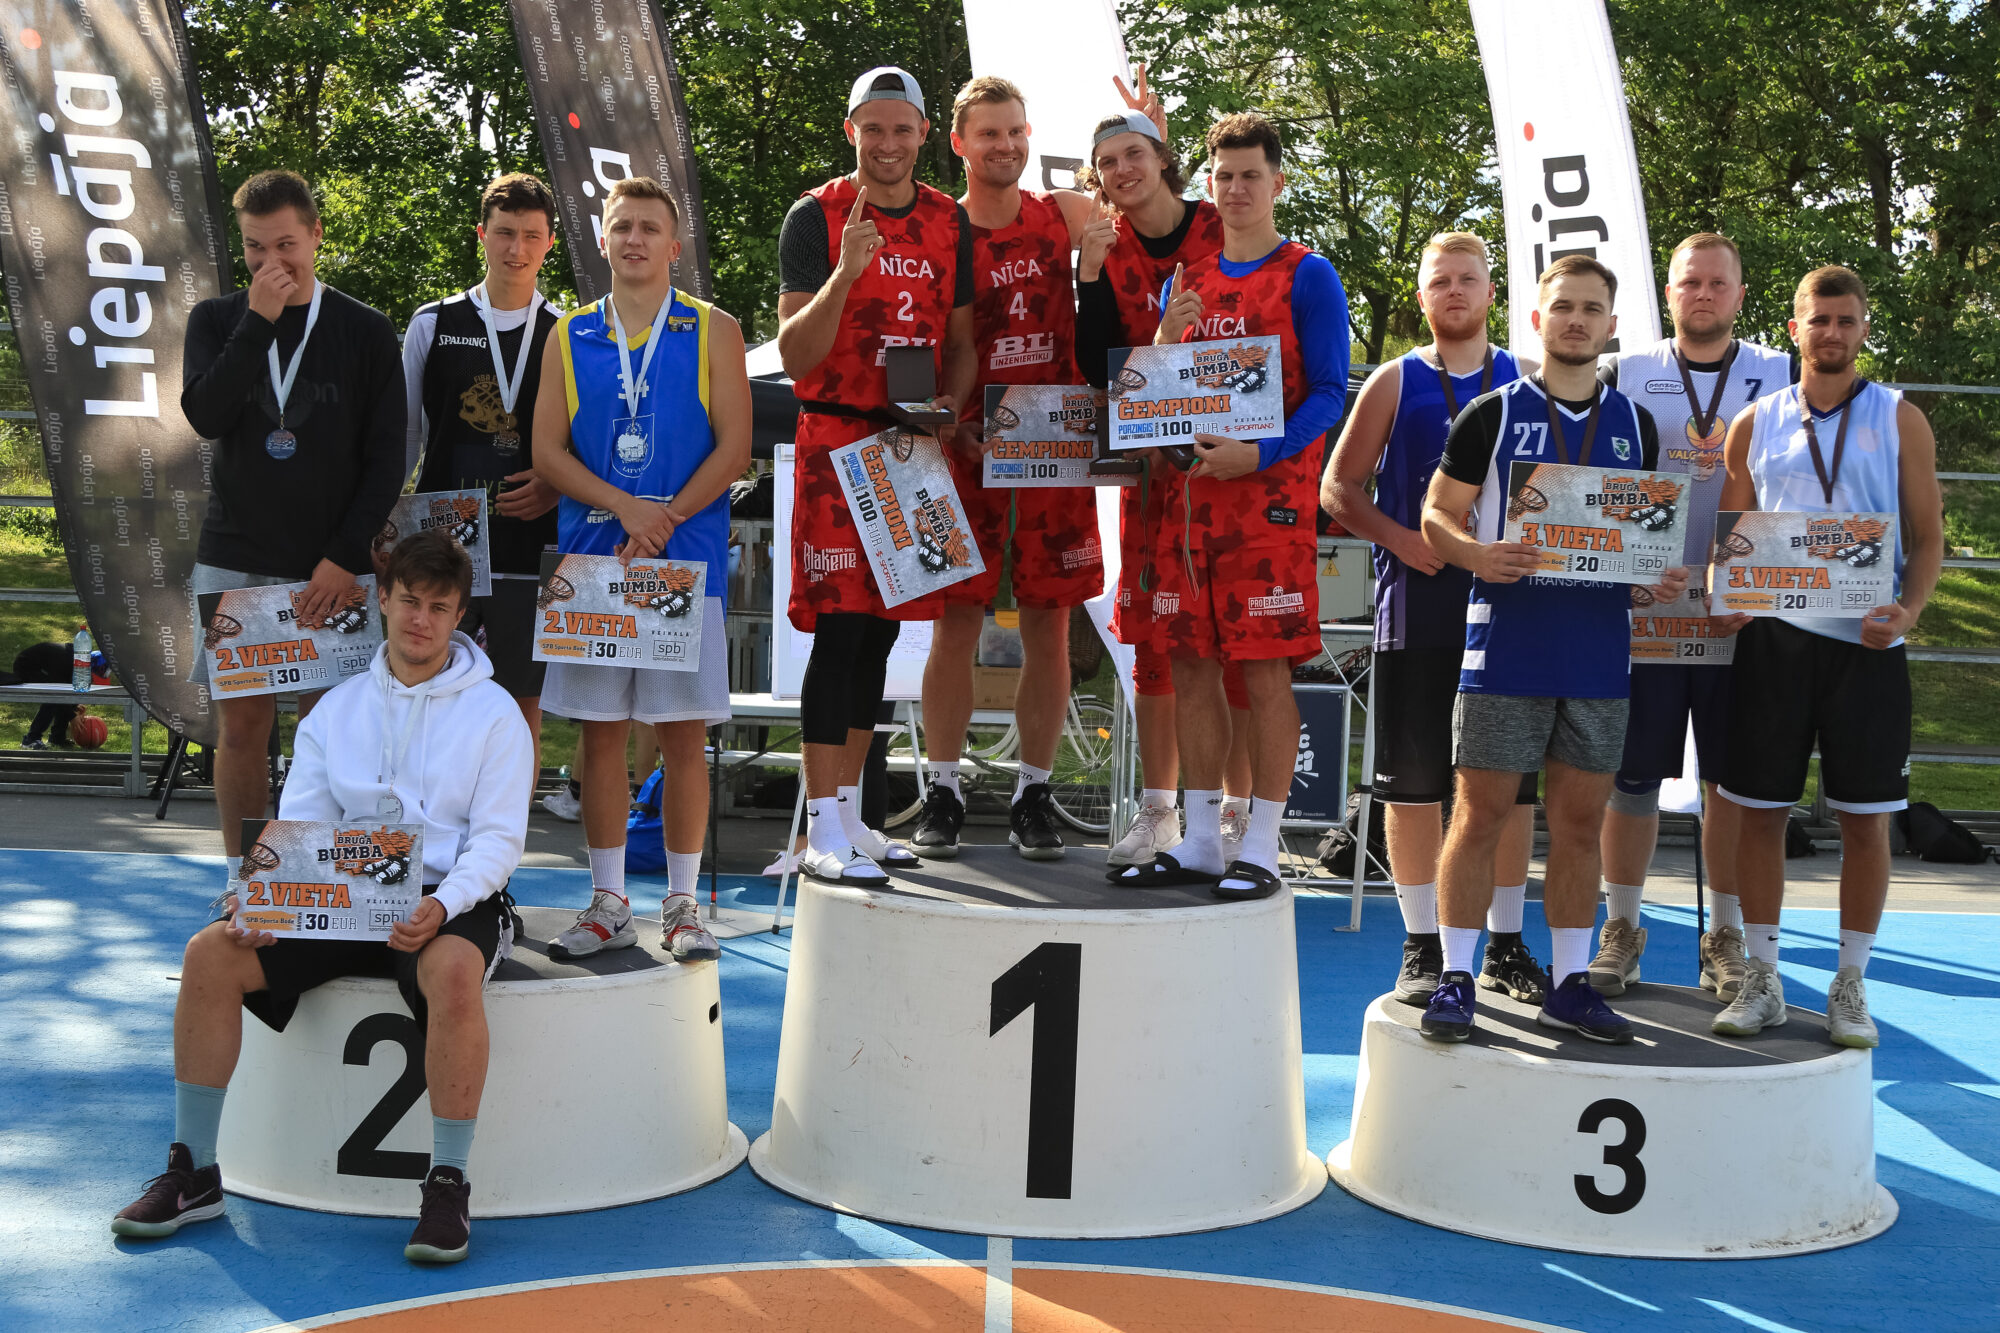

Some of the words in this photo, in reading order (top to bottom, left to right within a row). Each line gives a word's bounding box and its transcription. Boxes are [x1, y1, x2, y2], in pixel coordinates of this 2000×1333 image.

[533, 36, 549, 83] Liepāja
[572, 36, 588, 82] Liepāja
[618, 35, 634, 81] Liepāja
[600, 75, 616, 122] Liepāja
[646, 75, 660, 121] Liepāja
[38, 70, 167, 418] Liepāja
[879, 254, 934, 279] NĪCA
[990, 259, 1042, 288] NĪCA
[897, 291, 914, 322] 2
[1009, 292, 1028, 320] 4
[1194, 314, 1247, 337] NĪCA
[40, 320, 58, 374] Liepāja
[438, 334, 487, 349] SPALDING
[1179, 360, 1242, 380] BUMBA
[1744, 379, 1762, 402] 7
[1049, 409, 1096, 422] BUMB
[1118, 394, 1231, 420] ČEMPIONI
[1161, 421, 1192, 436] 100
[1514, 423, 1548, 455] 27
[137, 448, 154, 499] Liepāja
[1030, 464, 1058, 478] 100
[1060, 467, 1081, 478] EUR
[855, 491, 878, 523] 100
[860, 444, 914, 551] ČEMPIONI
[1585, 493, 1650, 506] BUMBA
[112, 496, 129, 547] Liepāja
[420, 511, 462, 529] BUMBA
[915, 488, 950, 546] BUMBA
[1521, 522, 1624, 553] 3.VIETA
[1790, 532, 1856, 548] BUMBA
[147, 537, 166, 588] Liepāja
[1078, 547, 1101, 559] BASKE
[1576, 556, 1598, 572] 20
[1638, 555, 1662, 570] spb
[87, 544, 106, 595] Liepāja
[1728, 566, 1831, 589] 3.VIETA
[608, 580, 669, 594] BUMBA
[1846, 591, 1872, 604] spb
[122, 585, 140, 636] Liepāja
[1251, 599, 1263, 608] PRO
[1784, 594, 1807, 609] 20
[1808, 596, 1833, 608] EUR
[543, 610, 638, 638] 2.VIETA
[1631, 617, 1727, 638] 3.VIET
[157, 626, 176, 676] Liepāja
[216, 639, 319, 671] 2.VIETA
[595, 642, 617, 658] 30
[619, 646, 642, 659] EUR
[658, 642, 681, 655] spb
[1684, 643, 1705, 657] 20
[277, 668, 300, 684] 30
[302, 667, 328, 680] EUR
[343, 656, 367, 669] spb
[317, 845, 384, 861] BUMBA
[247, 882, 352, 908] 2.VIETA
[305, 914, 329, 930] 30
[331, 917, 357, 929] EUR
[988, 941, 1082, 1200] 1
[337, 1012, 431, 1180] 2
[1574, 1098, 1647, 1215] 3
